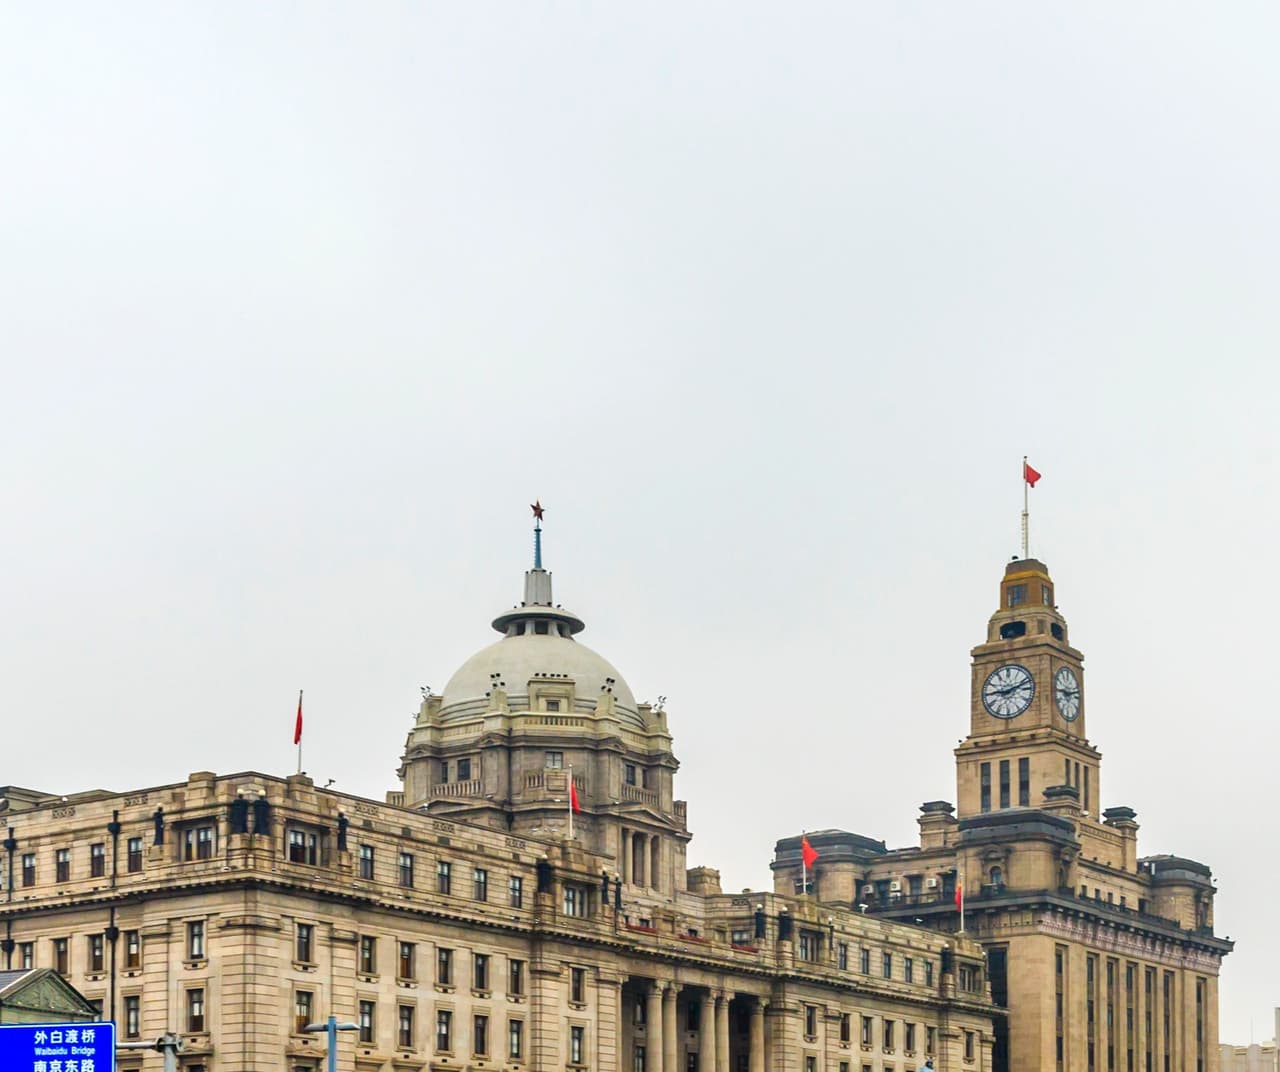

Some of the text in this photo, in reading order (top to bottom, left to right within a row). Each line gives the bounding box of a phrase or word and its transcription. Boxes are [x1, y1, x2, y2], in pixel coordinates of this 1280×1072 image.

[34, 1029, 96, 1044] 外白渡桥
[34, 1046, 96, 1056] Waibaidu Bridge
